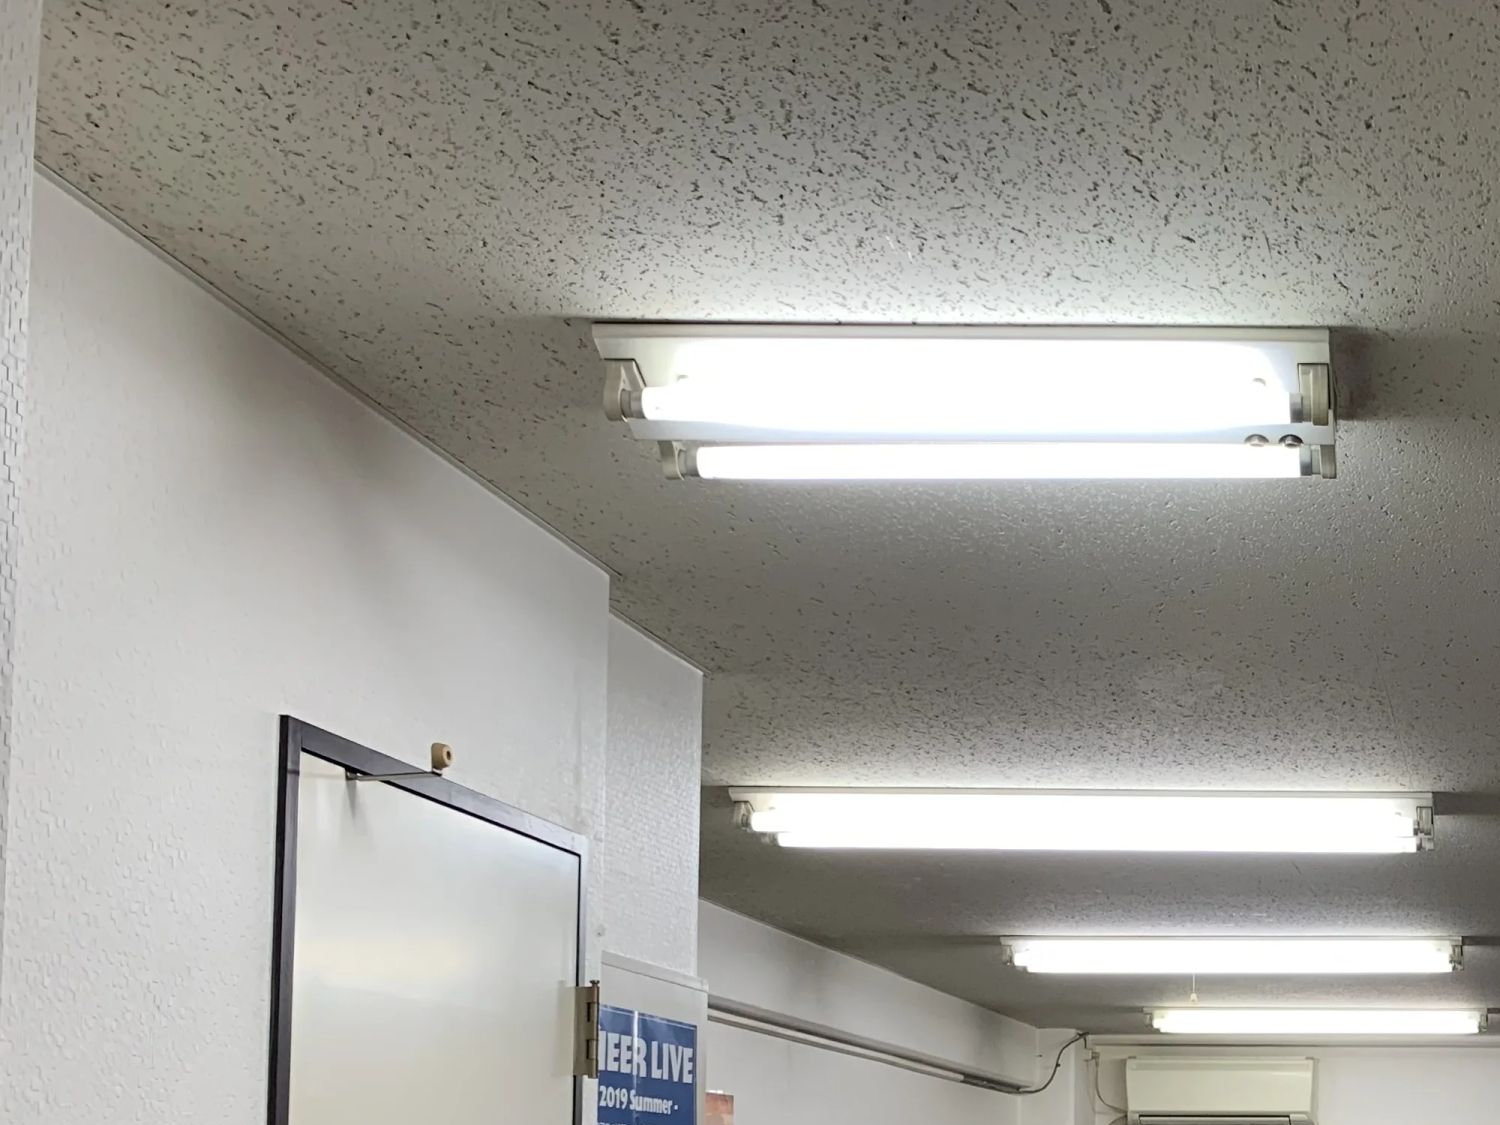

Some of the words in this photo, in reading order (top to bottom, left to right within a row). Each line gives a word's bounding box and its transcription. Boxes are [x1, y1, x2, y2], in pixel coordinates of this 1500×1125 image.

[651, 1041, 693, 1083] LIVE
[599, 1085, 628, 1110] 2019
[629, 1089, 673, 1115] Summer
